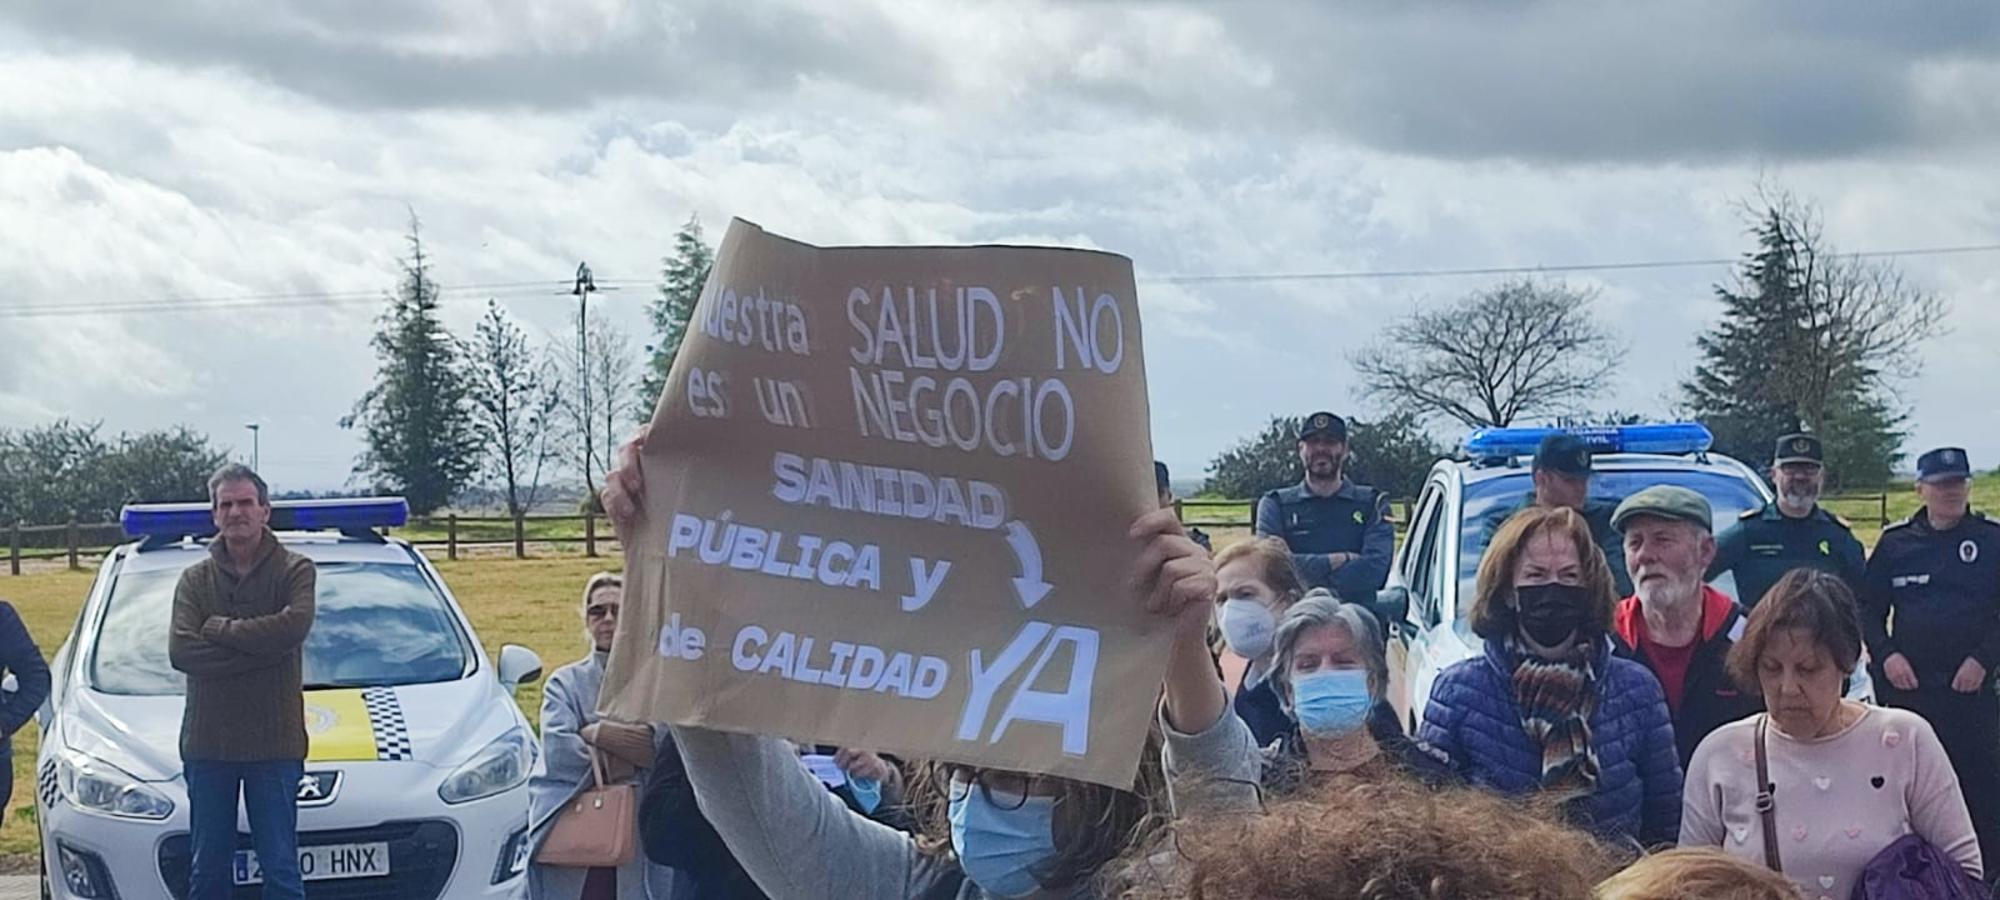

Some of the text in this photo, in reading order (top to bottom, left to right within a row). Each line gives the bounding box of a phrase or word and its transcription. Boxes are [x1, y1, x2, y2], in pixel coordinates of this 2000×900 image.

[847, 286, 1004, 371] SALUD
[1053, 286, 1123, 373] NO
[687, 366, 1075, 461] es un NEGOCIO
[773, 452, 1005, 529] SANIDAD
[668, 509, 952, 612] PÚBLICA y
[659, 613, 1099, 756] de CALIDAD YA
[331, 848, 376, 873] HNX
